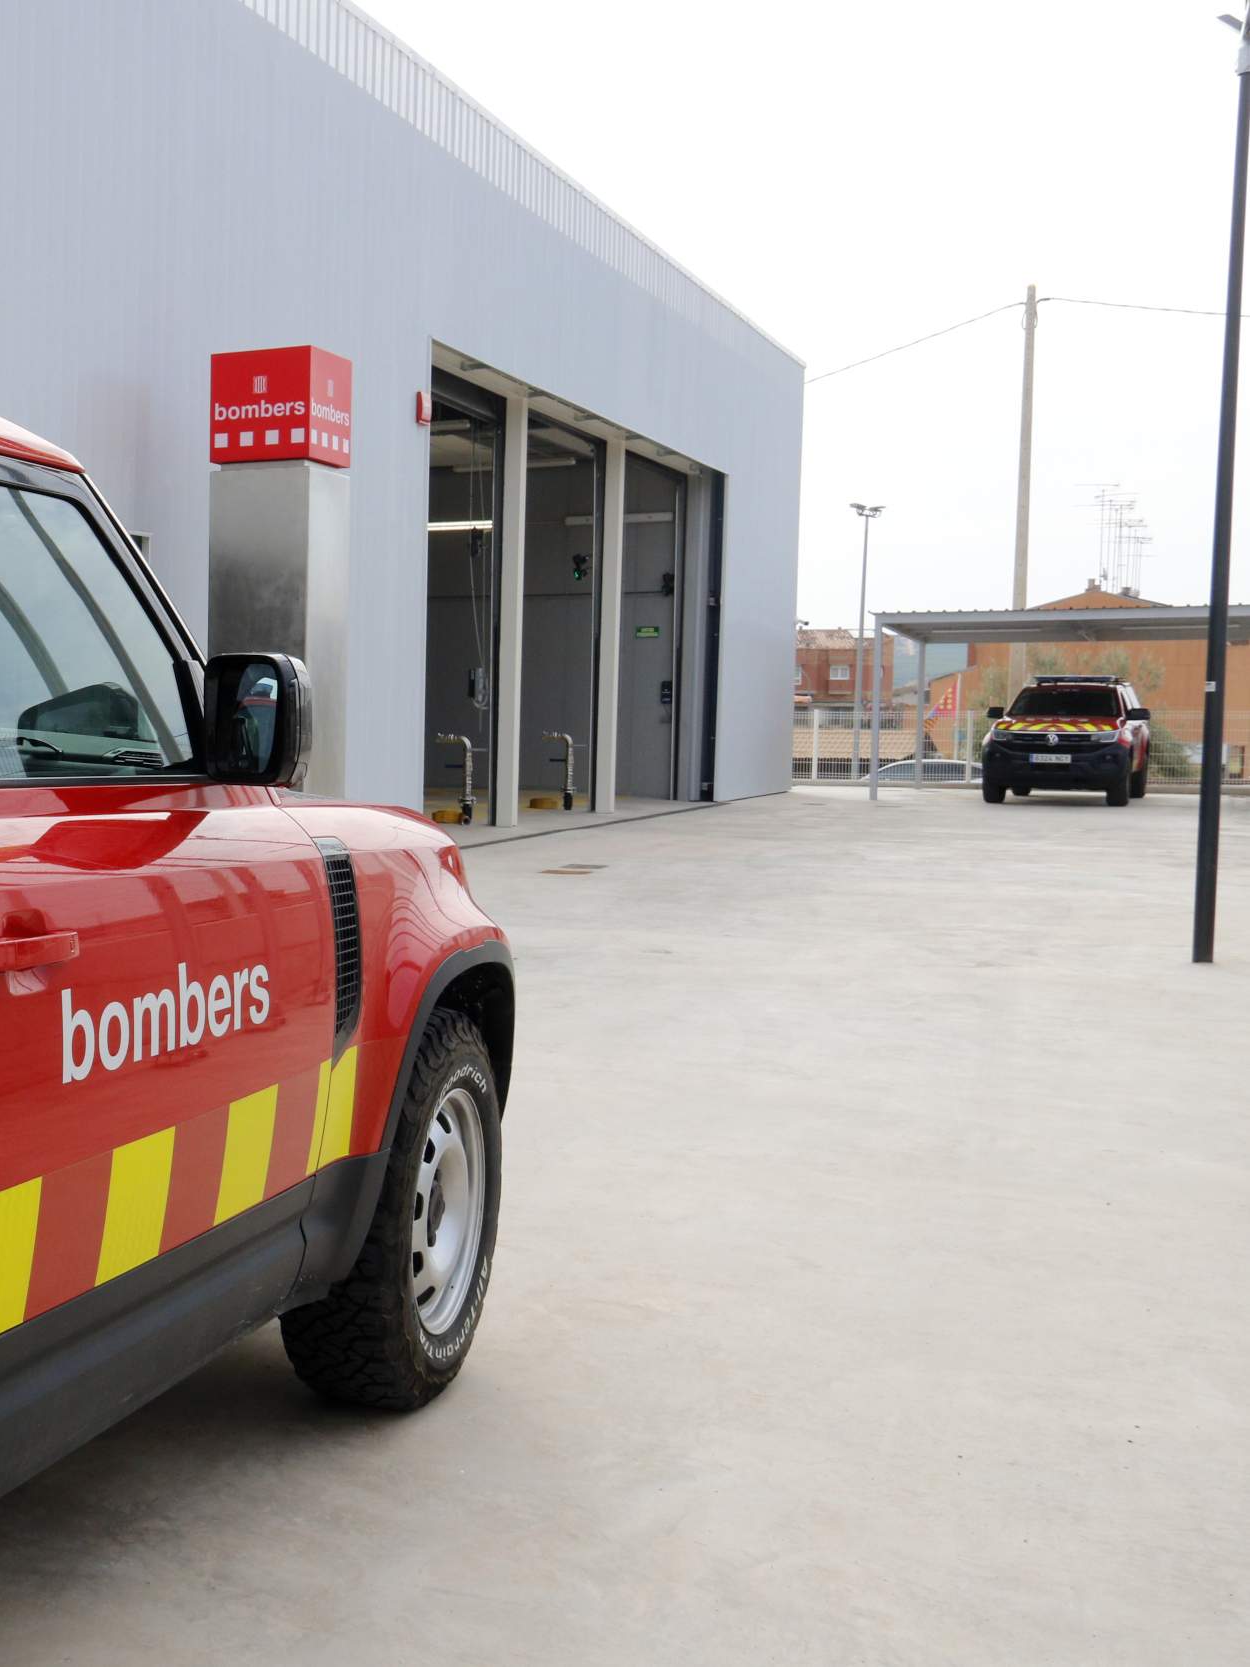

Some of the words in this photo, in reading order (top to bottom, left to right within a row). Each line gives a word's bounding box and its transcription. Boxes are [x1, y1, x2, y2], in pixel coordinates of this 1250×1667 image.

[214, 400, 306, 421] bombers
[310, 397, 350, 427] bombers
[61, 962, 270, 1084] bombers
